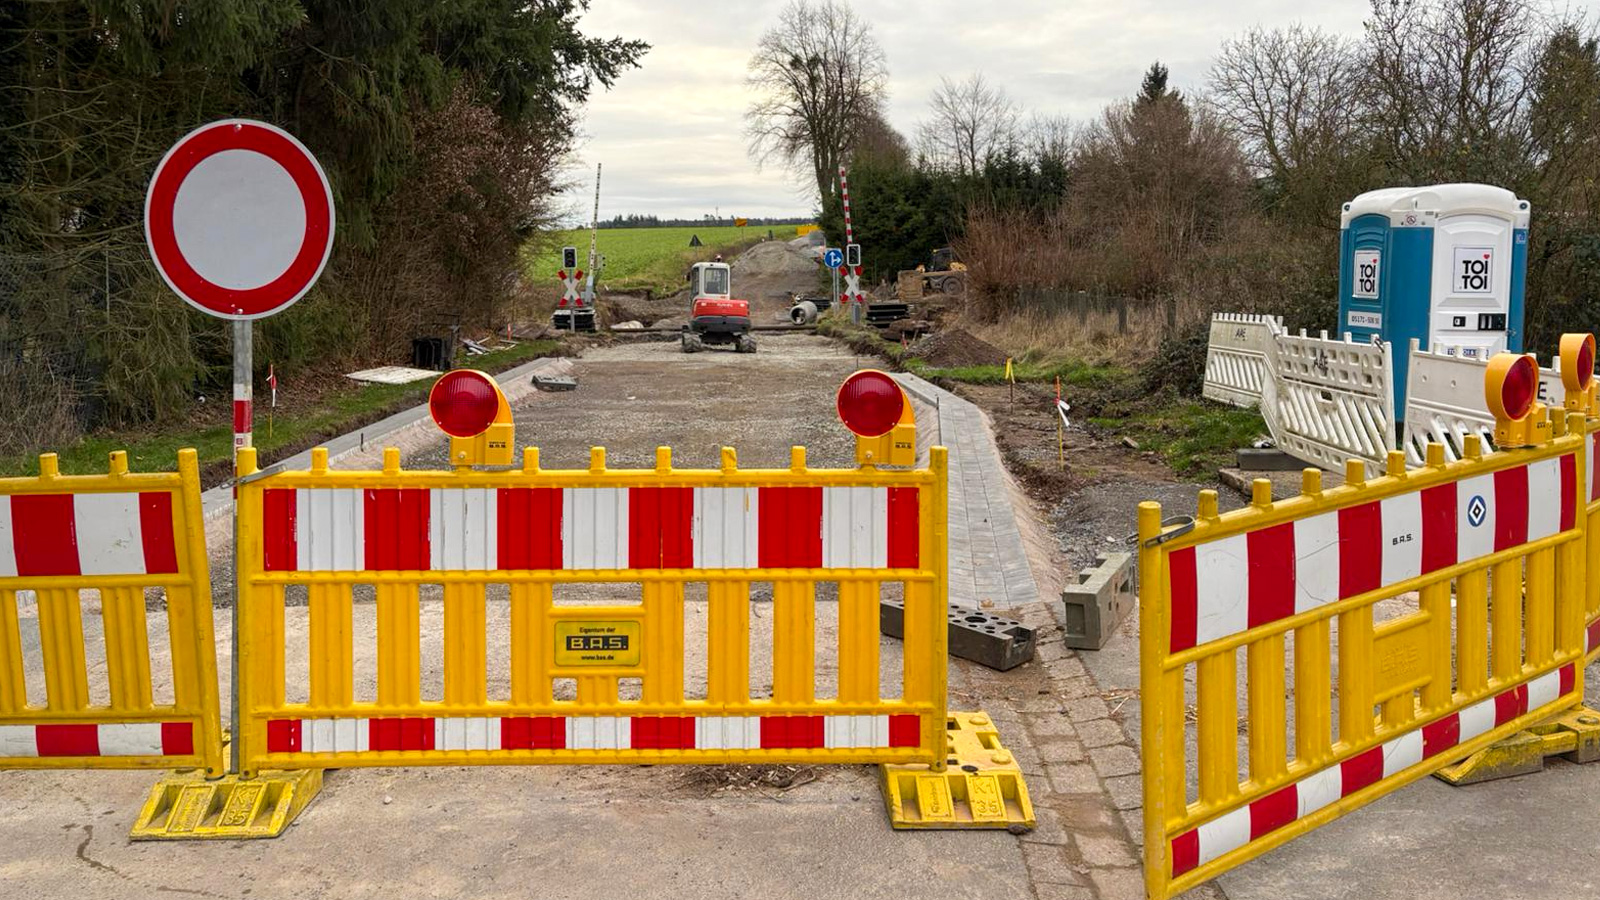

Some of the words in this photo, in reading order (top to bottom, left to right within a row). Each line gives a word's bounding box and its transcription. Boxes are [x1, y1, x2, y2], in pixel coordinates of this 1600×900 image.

[1360, 264, 1376, 278] TOI
[1462, 260, 1488, 275] TOI
[1359, 279, 1375, 293] TOI
[1461, 275, 1488, 290] TOI
[570, 637, 627, 649] B.A.S.
